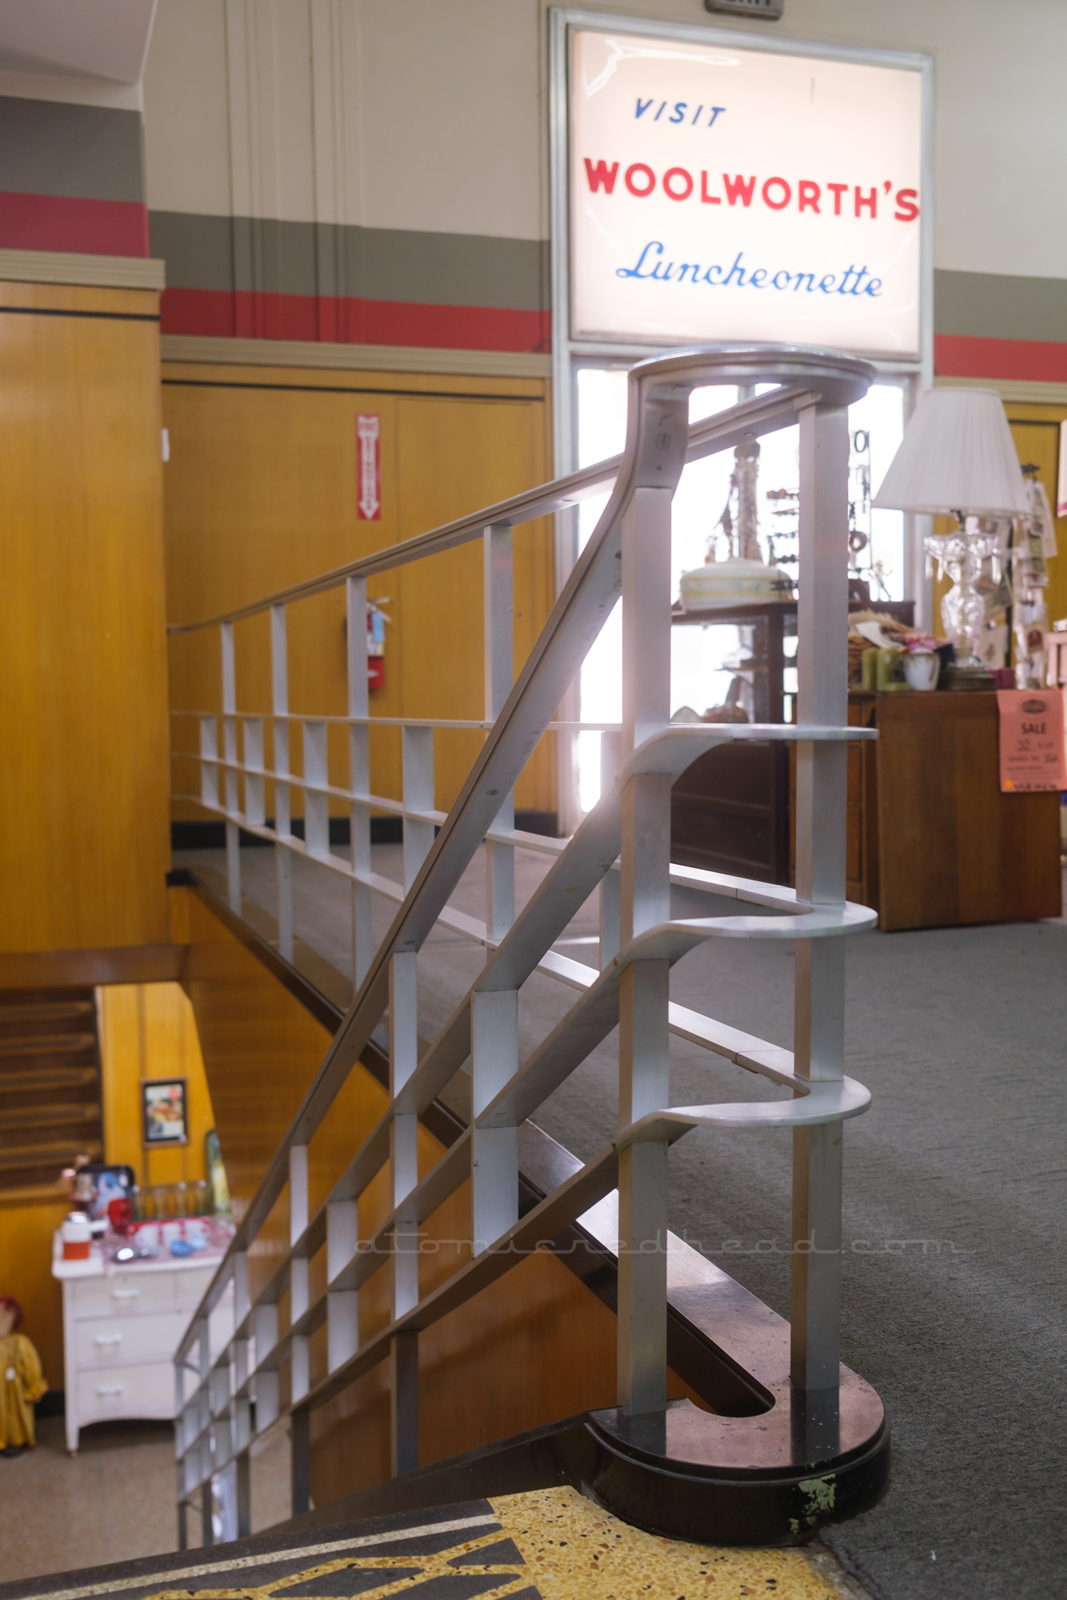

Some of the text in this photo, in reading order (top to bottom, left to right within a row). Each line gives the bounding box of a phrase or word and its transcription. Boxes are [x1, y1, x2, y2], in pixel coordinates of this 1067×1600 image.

[635, 98, 726, 127] VISIT
[584, 157, 920, 222] WOOLWORTH'S
[615, 240, 883, 298] Luncheonette
[1021, 723, 1047, 735] SALE
